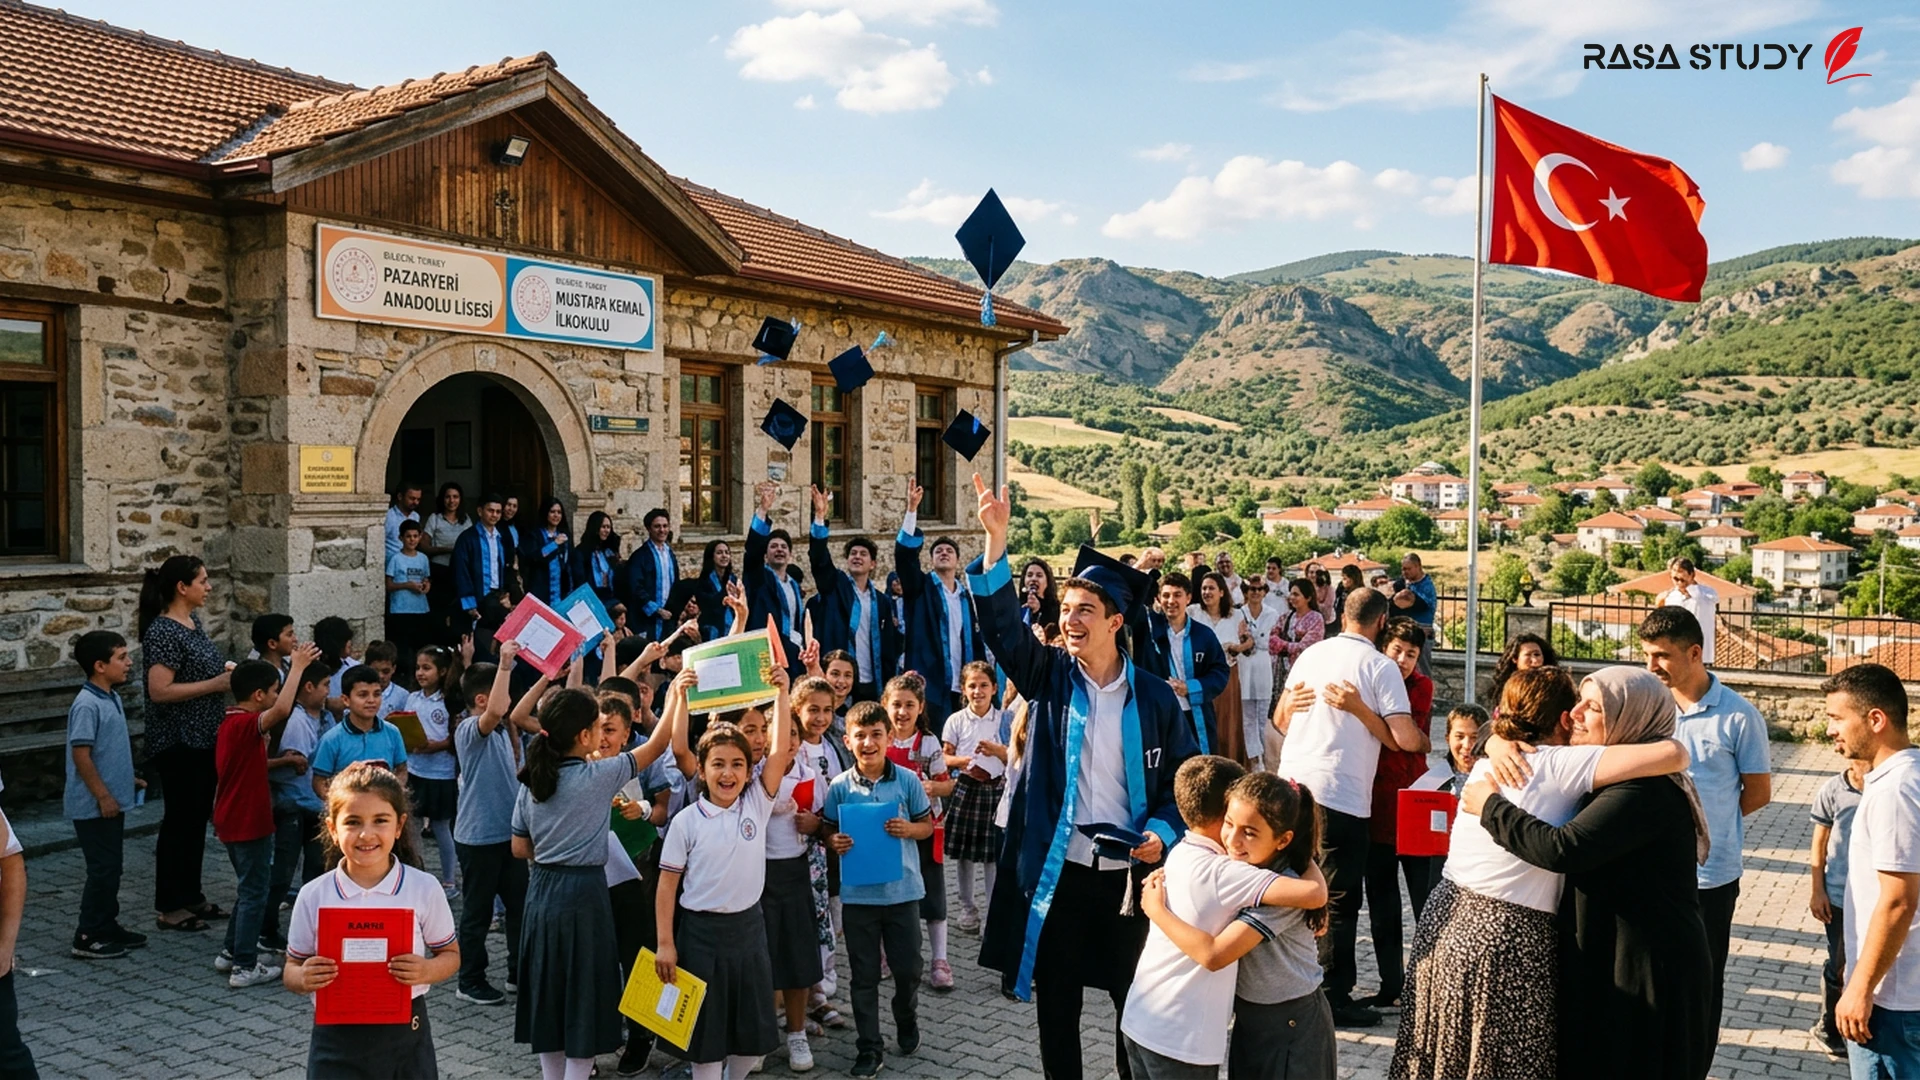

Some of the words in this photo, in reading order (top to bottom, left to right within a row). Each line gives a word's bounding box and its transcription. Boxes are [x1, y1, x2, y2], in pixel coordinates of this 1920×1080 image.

[384, 267, 459, 292] PAZARYERİ
[383, 291, 451, 313] ANADOLU
[455, 298, 493, 319] LİSESİ
[609, 298, 645, 317] KEMAL
[556, 310, 610, 332] İLKOKULU
[1145, 748, 1162, 769] 17
